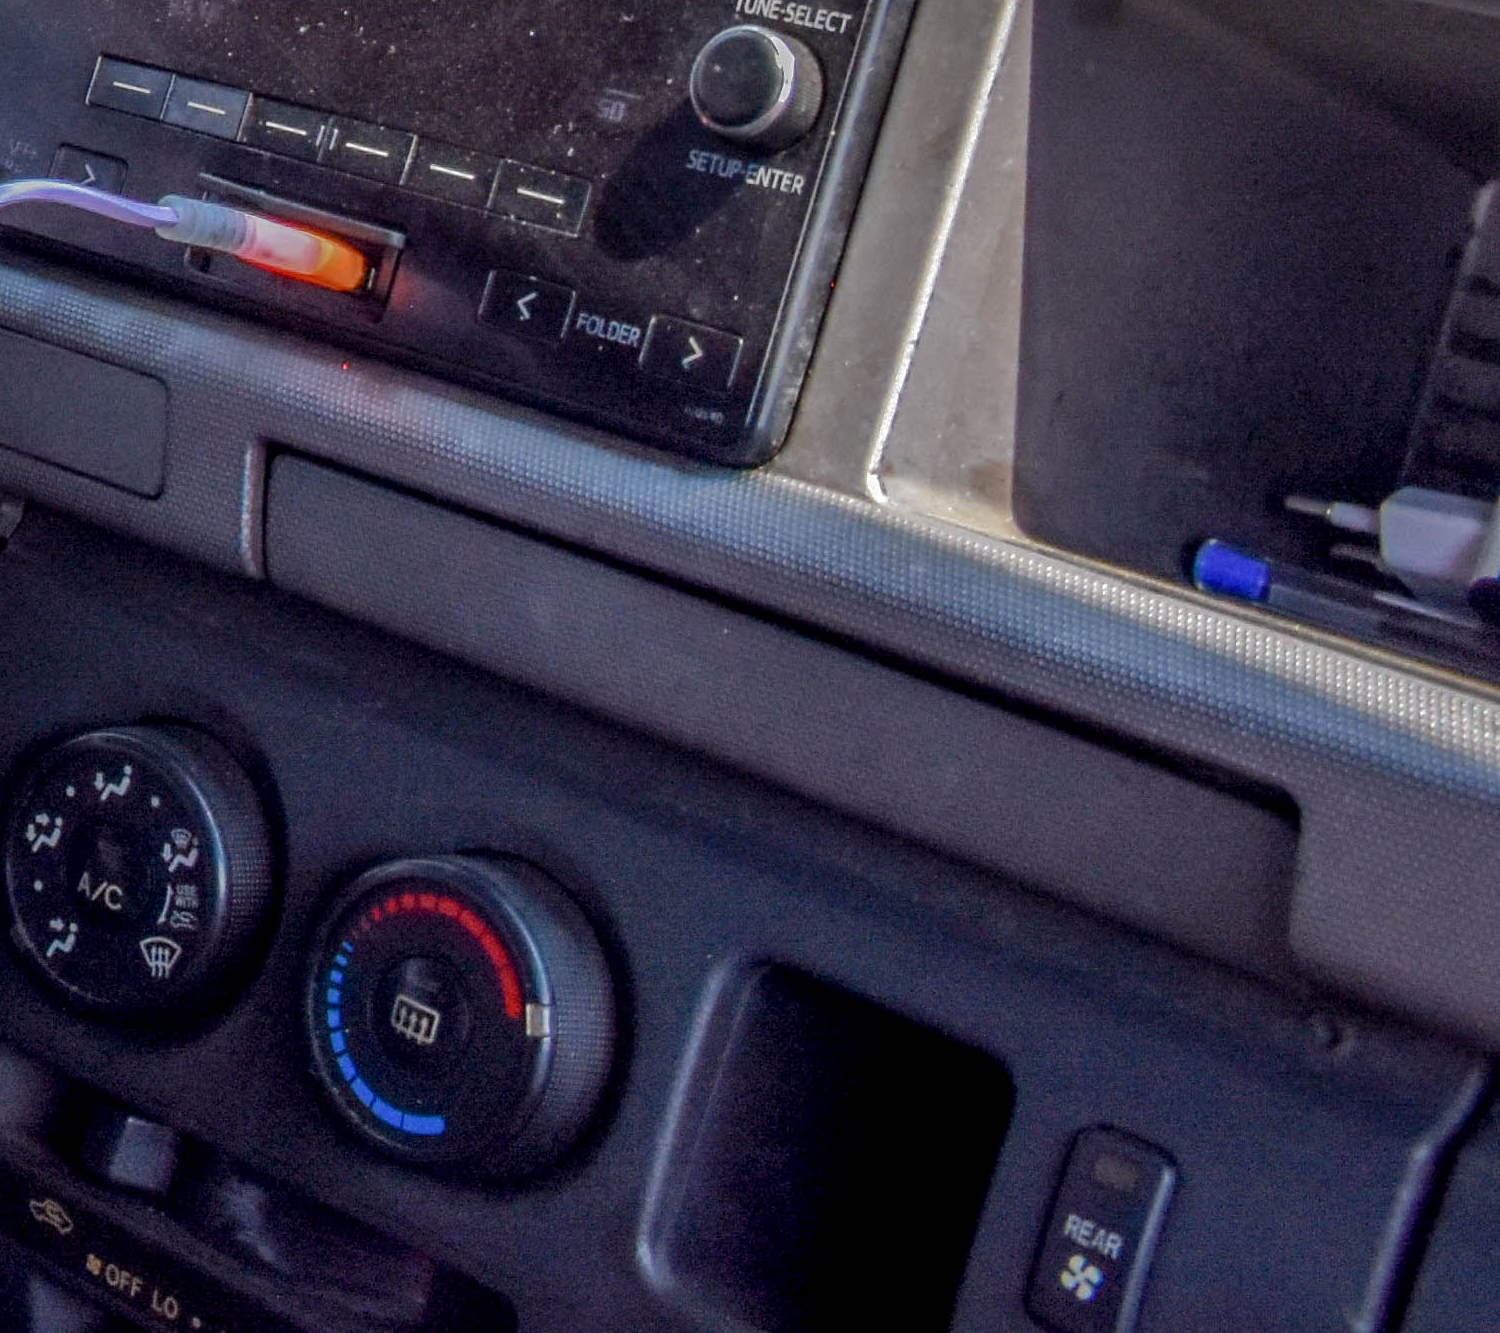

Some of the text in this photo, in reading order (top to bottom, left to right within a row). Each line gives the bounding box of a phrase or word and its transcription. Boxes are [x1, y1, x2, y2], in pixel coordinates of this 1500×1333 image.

[577, 313, 641, 348] FOLDER
[78, 871, 123, 910] A/C
[1064, 1214, 1122, 1259] REAR
[105, 1263, 178, 1319] OFF LO
